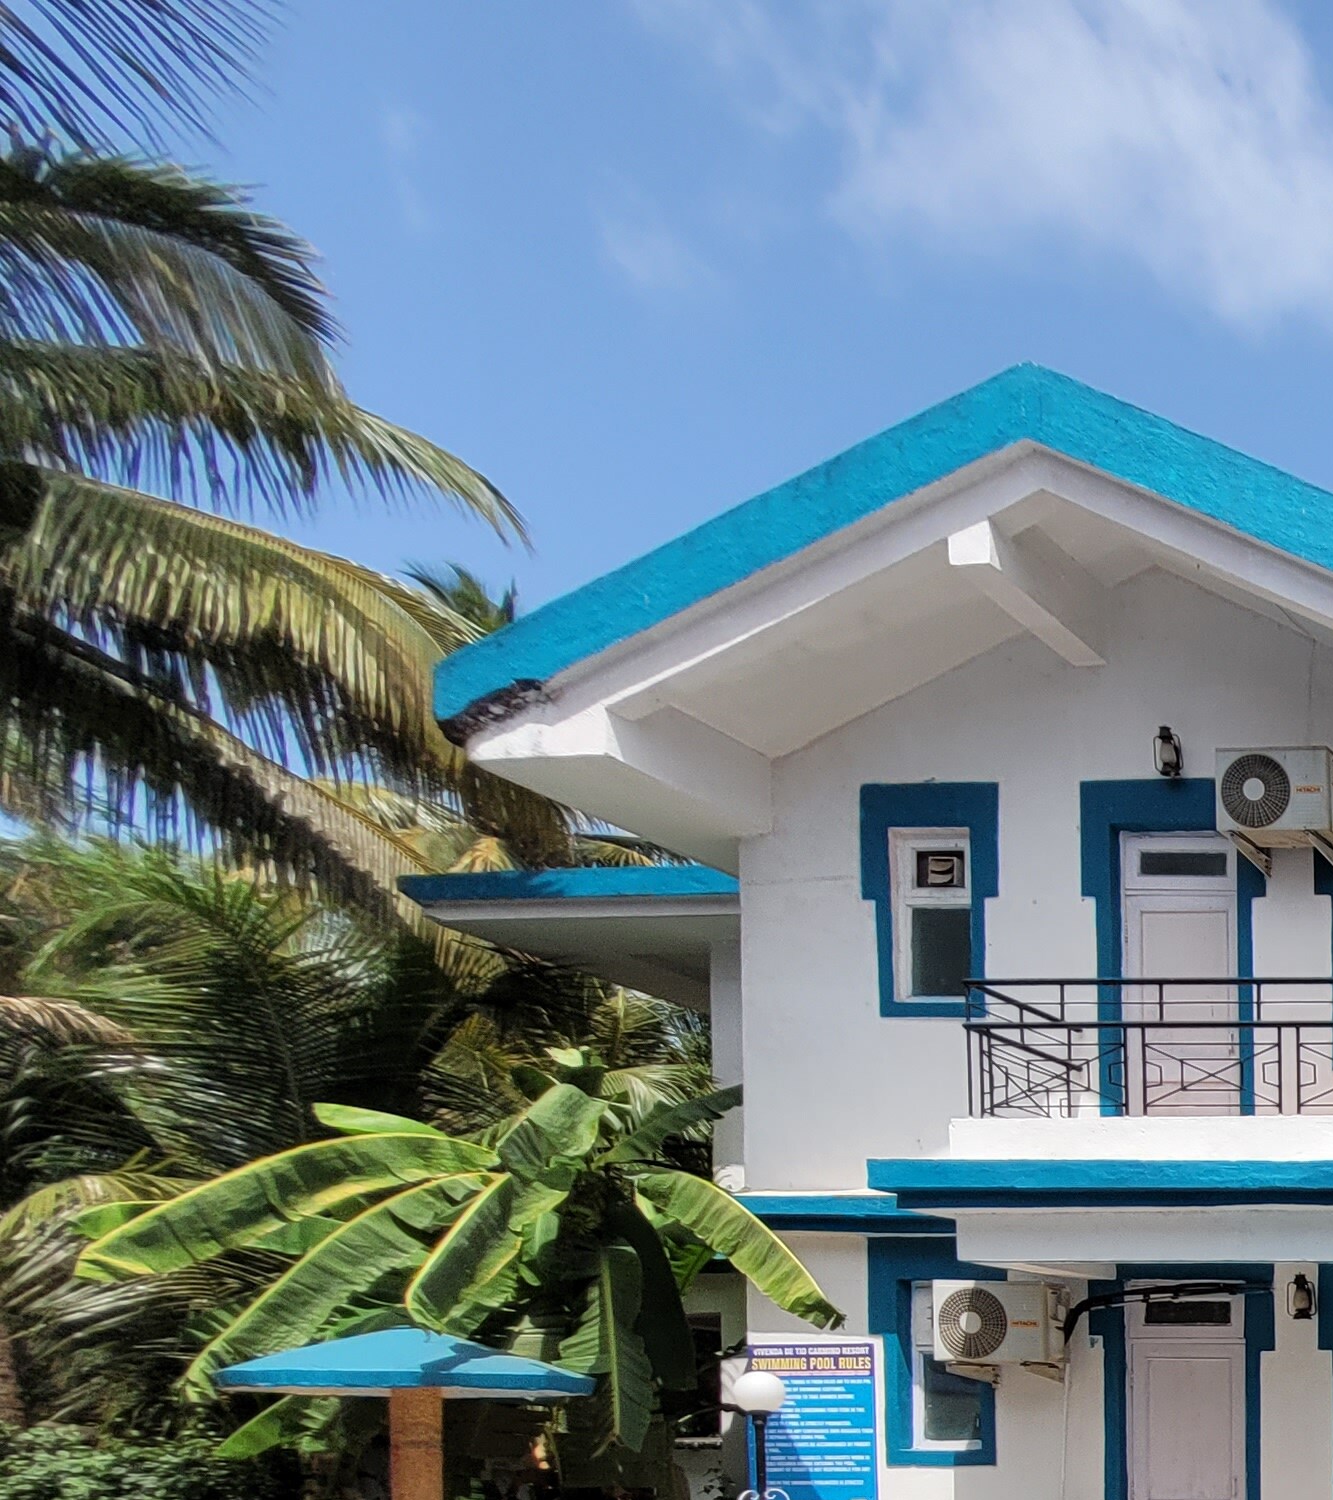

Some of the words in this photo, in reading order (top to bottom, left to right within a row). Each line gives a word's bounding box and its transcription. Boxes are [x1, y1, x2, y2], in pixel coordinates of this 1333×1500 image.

[751, 1357, 807, 1370] SWIMMING
[809, 1357, 836, 1370] POOL
[838, 1356, 872, 1369] RULES
